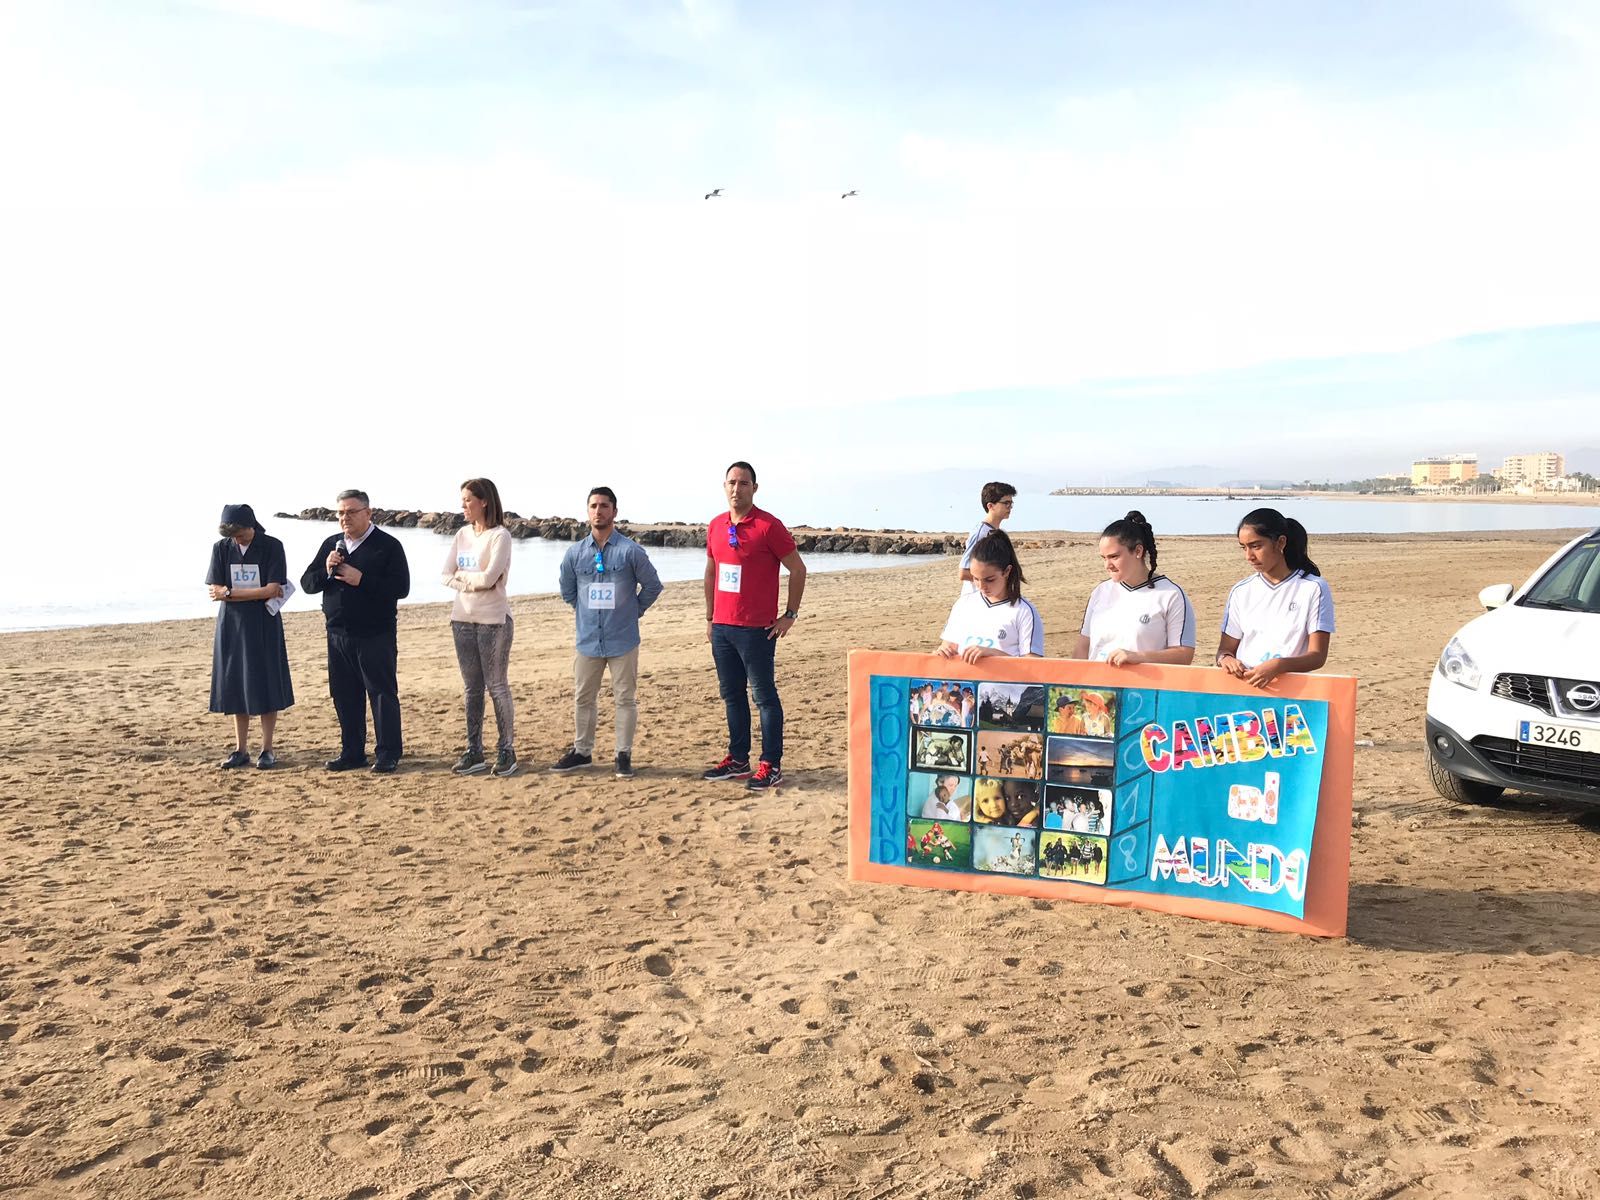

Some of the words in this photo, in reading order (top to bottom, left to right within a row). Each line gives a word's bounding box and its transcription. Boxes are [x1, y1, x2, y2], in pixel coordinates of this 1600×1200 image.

[233, 571, 257, 582] 167
[590, 589, 613, 600] 812
[1140, 704, 1317, 773] CAMBIA
[1533, 725, 1581, 747] 3246
[1150, 834, 1308, 902] MUNDO
